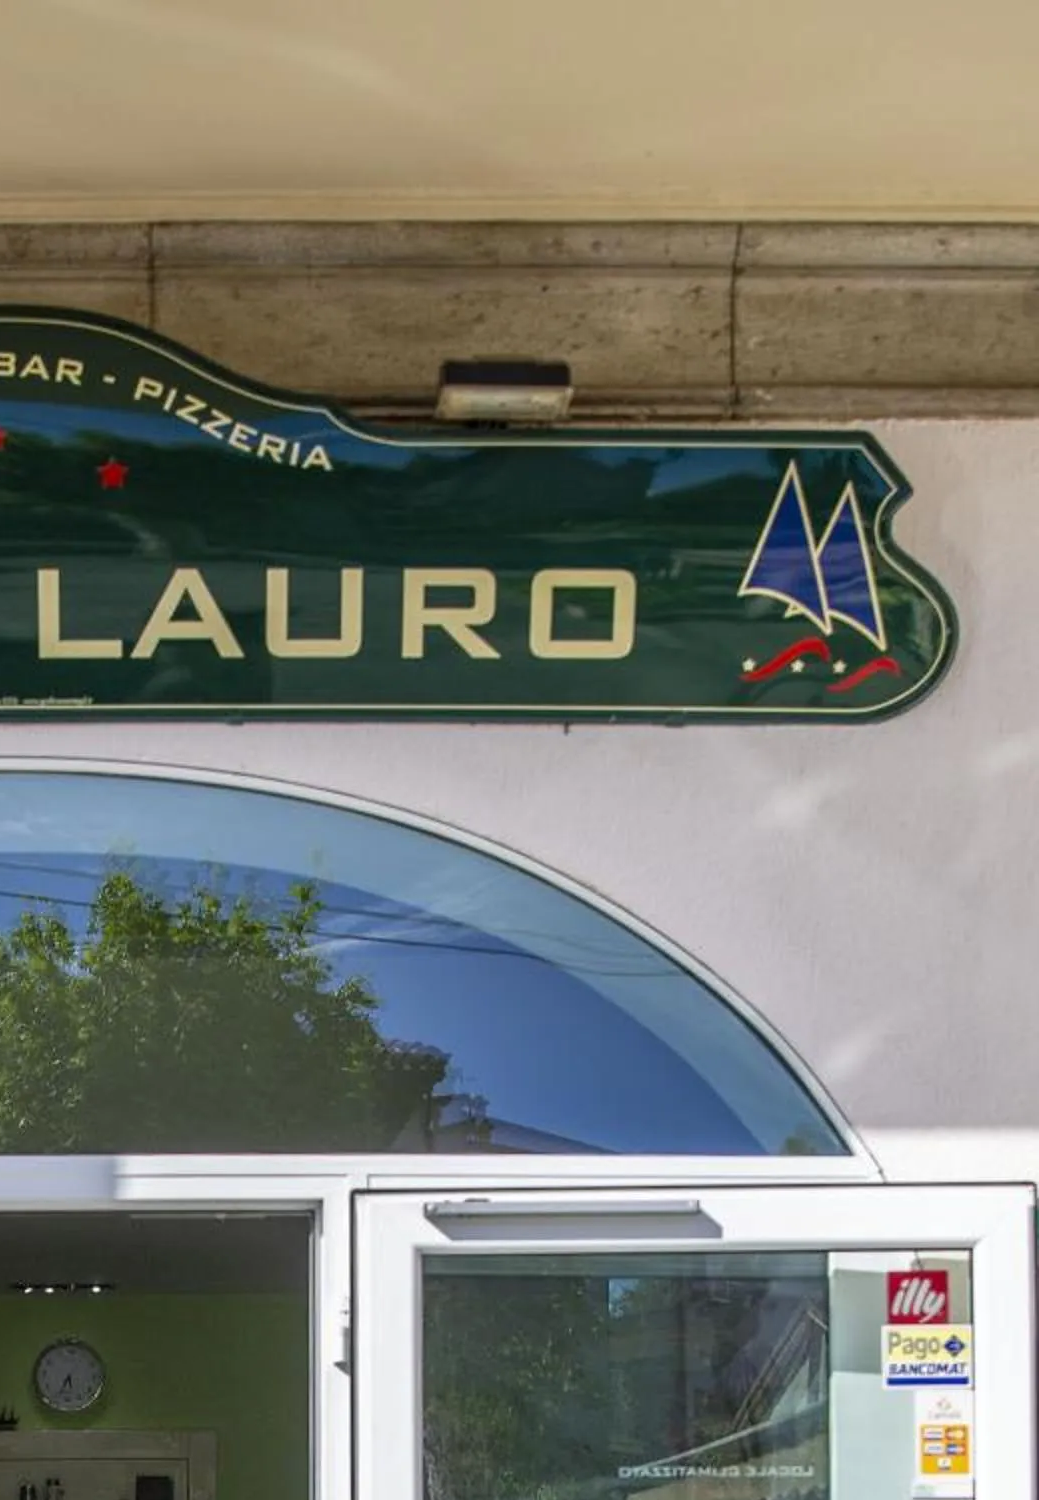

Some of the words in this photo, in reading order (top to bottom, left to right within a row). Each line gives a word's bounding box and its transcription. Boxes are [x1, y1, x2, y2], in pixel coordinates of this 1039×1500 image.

[133, 376, 333, 472] PIZZERIA
[38, 568, 636, 660] LAURO
[891, 1277, 946, 1323] illy
[888, 1332, 941, 1360] Pago
[888, 1363, 967, 1375] BANCOMAT
